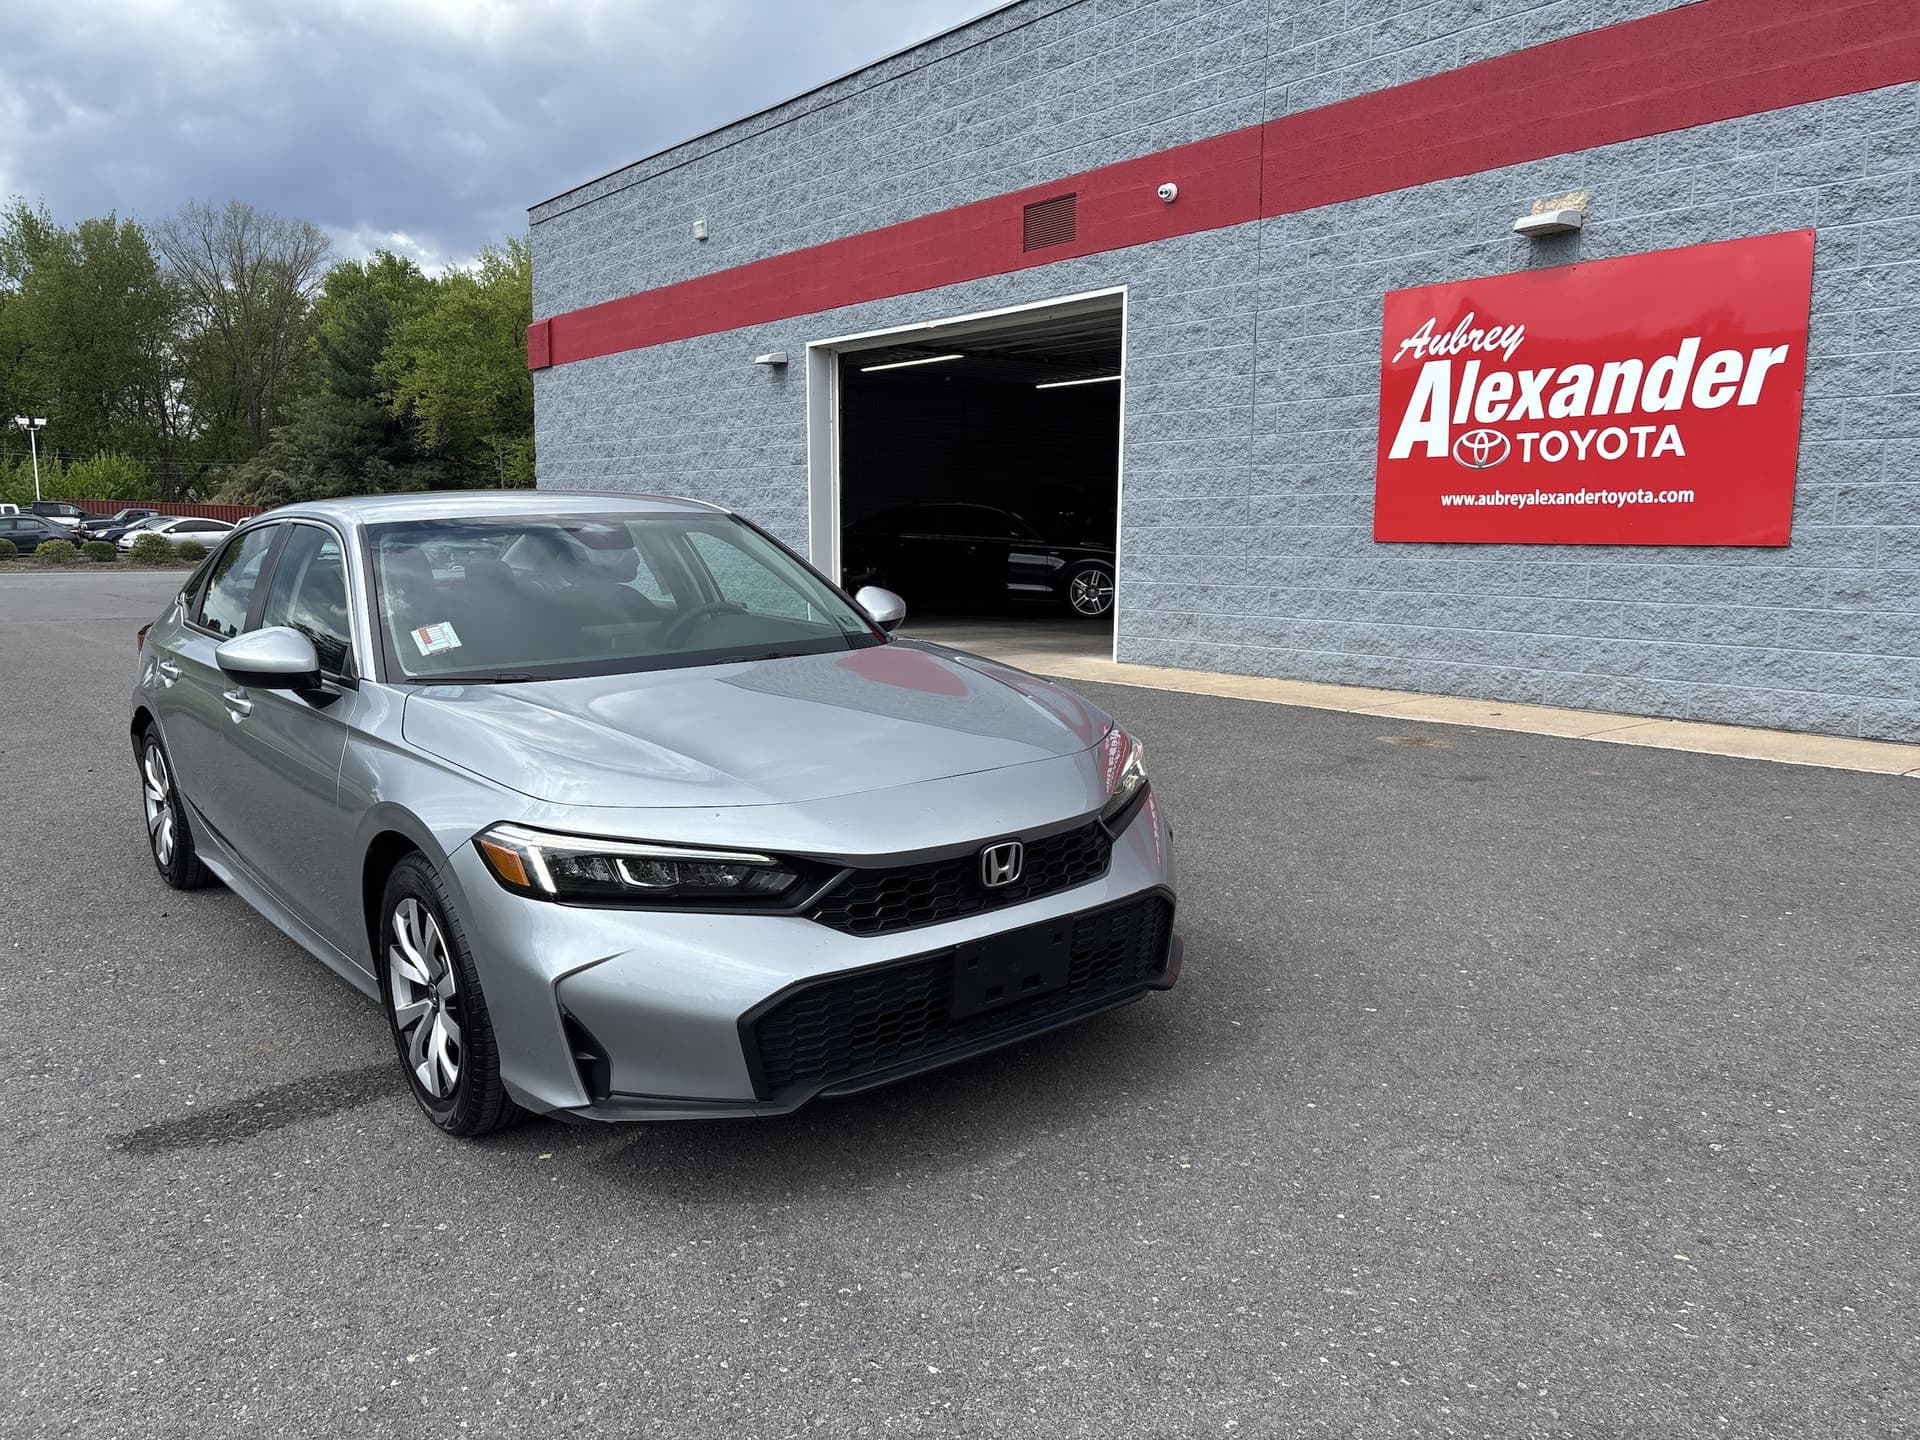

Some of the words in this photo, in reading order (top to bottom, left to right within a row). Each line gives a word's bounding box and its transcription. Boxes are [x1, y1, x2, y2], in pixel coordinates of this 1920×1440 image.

[1392, 312, 1526, 362] Aubrey
[1388, 337, 1790, 460] Alexander
[1516, 424, 1686, 463] TOYOTA
[1441, 486, 1695, 509] www.aubreyalexandertoyota.com
